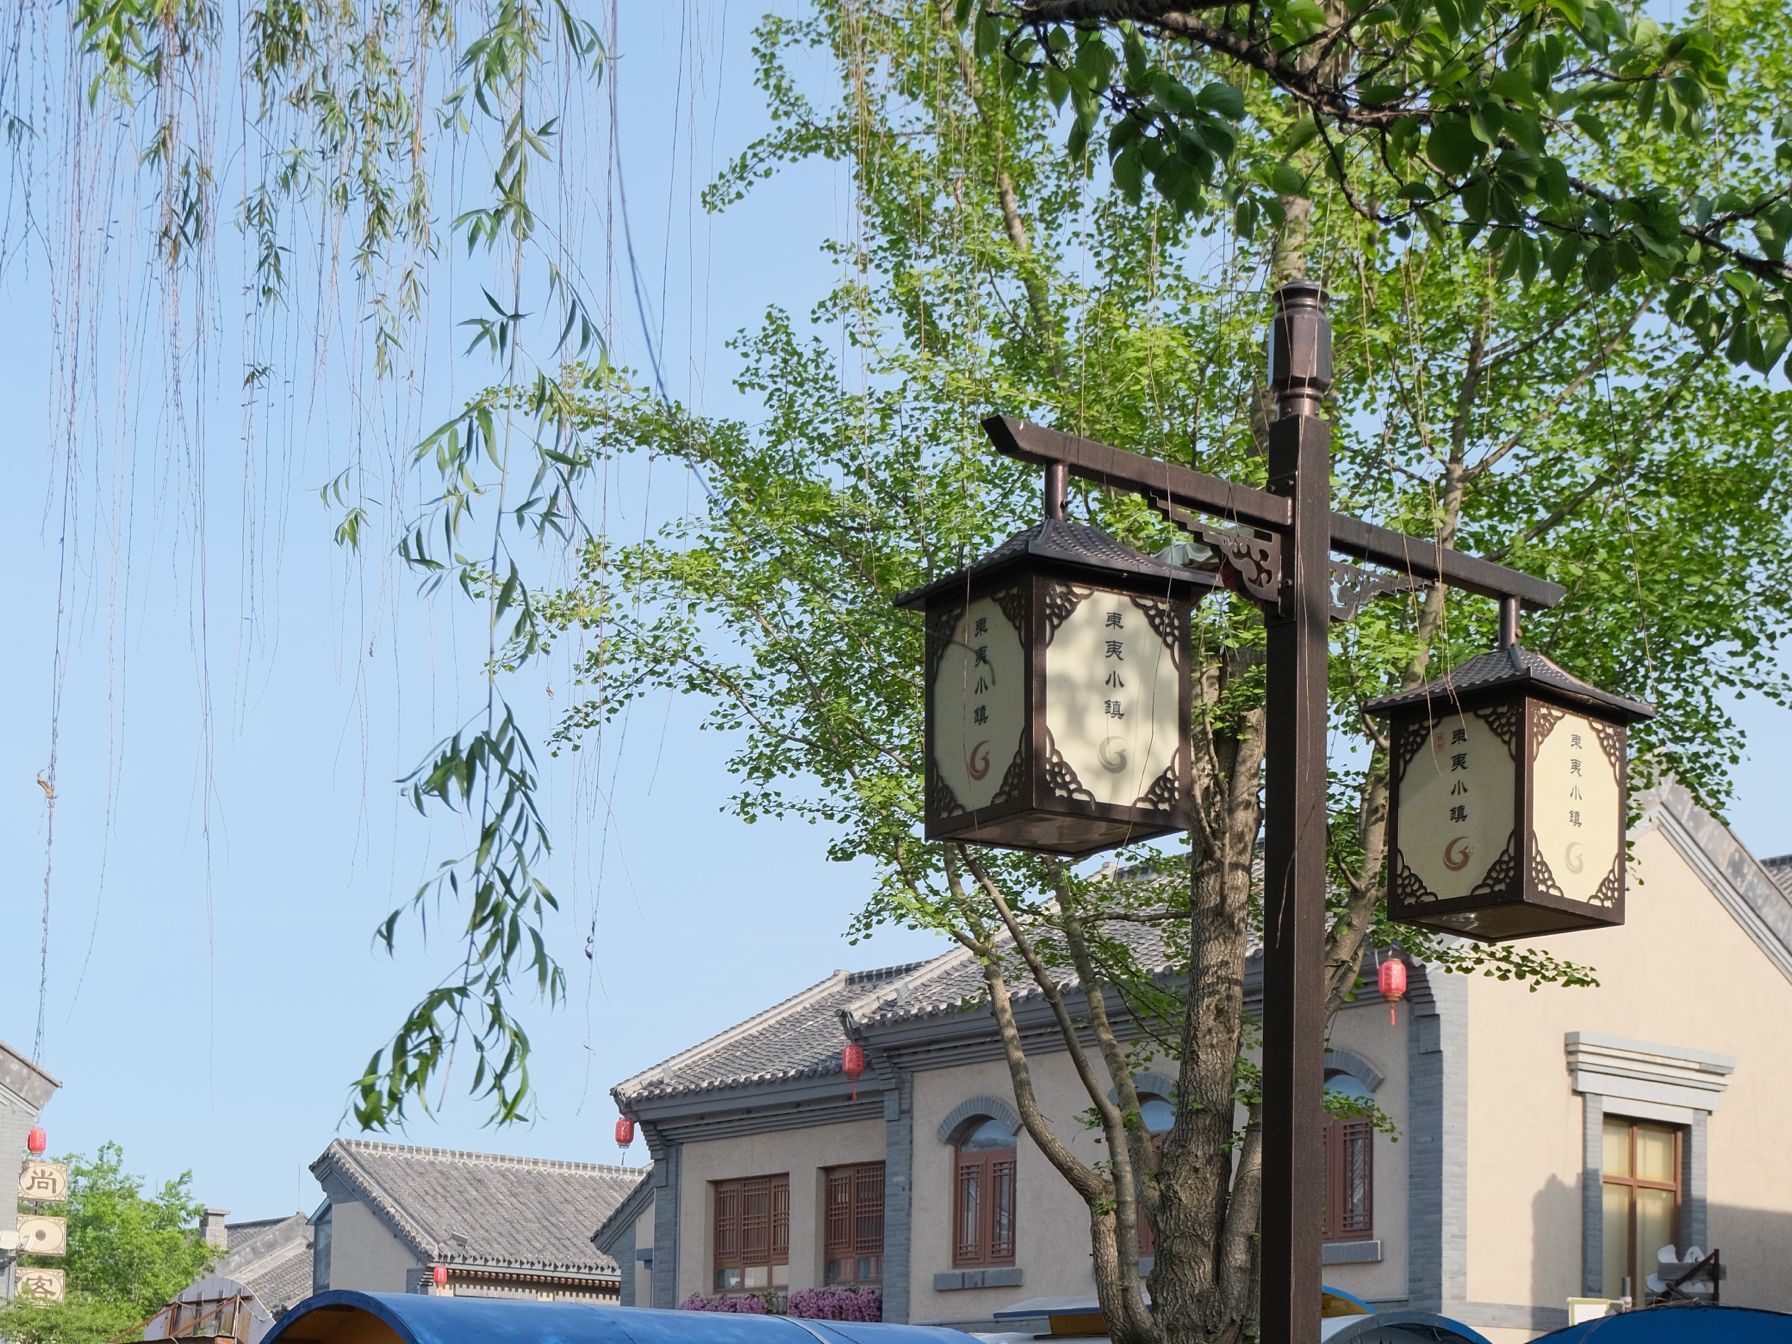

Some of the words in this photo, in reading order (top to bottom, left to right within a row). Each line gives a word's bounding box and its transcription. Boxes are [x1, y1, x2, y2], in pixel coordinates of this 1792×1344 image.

[974, 617, 988, 726] 東夷小鎮
[1105, 612, 1125, 719] 東夷小鎮
[1450, 728, 1468, 823] 東夷小鎮
[1569, 733, 1583, 828] 東夷小鎮
